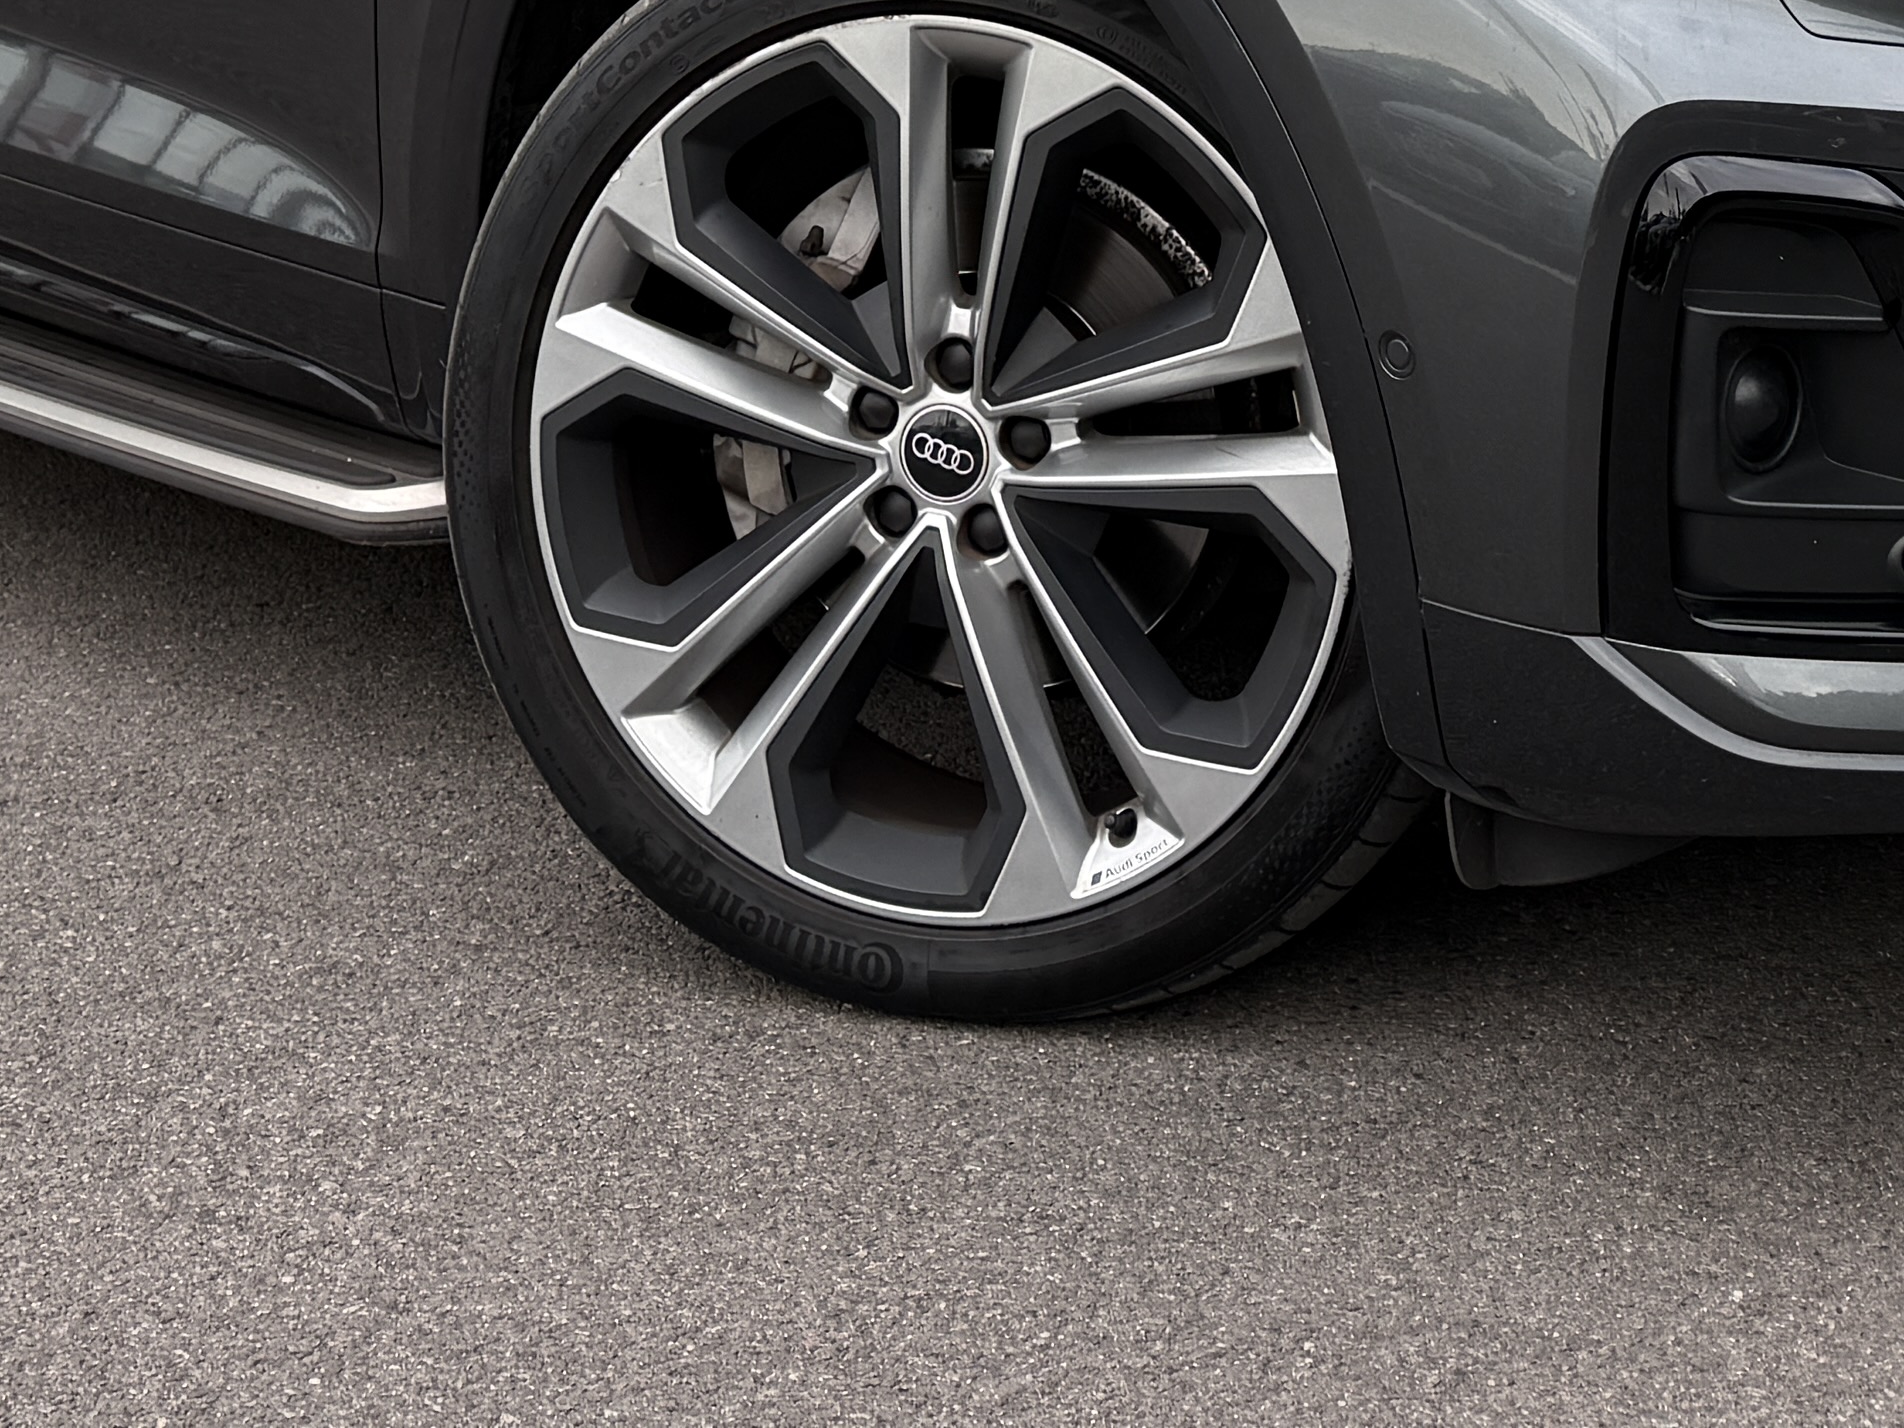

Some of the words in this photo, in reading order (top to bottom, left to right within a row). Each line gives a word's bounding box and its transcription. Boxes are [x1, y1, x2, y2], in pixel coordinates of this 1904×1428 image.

[1105, 857, 1134, 879] Audi
[1135, 839, 1169, 863] Sport
[656, 850, 904, 996] Continental
